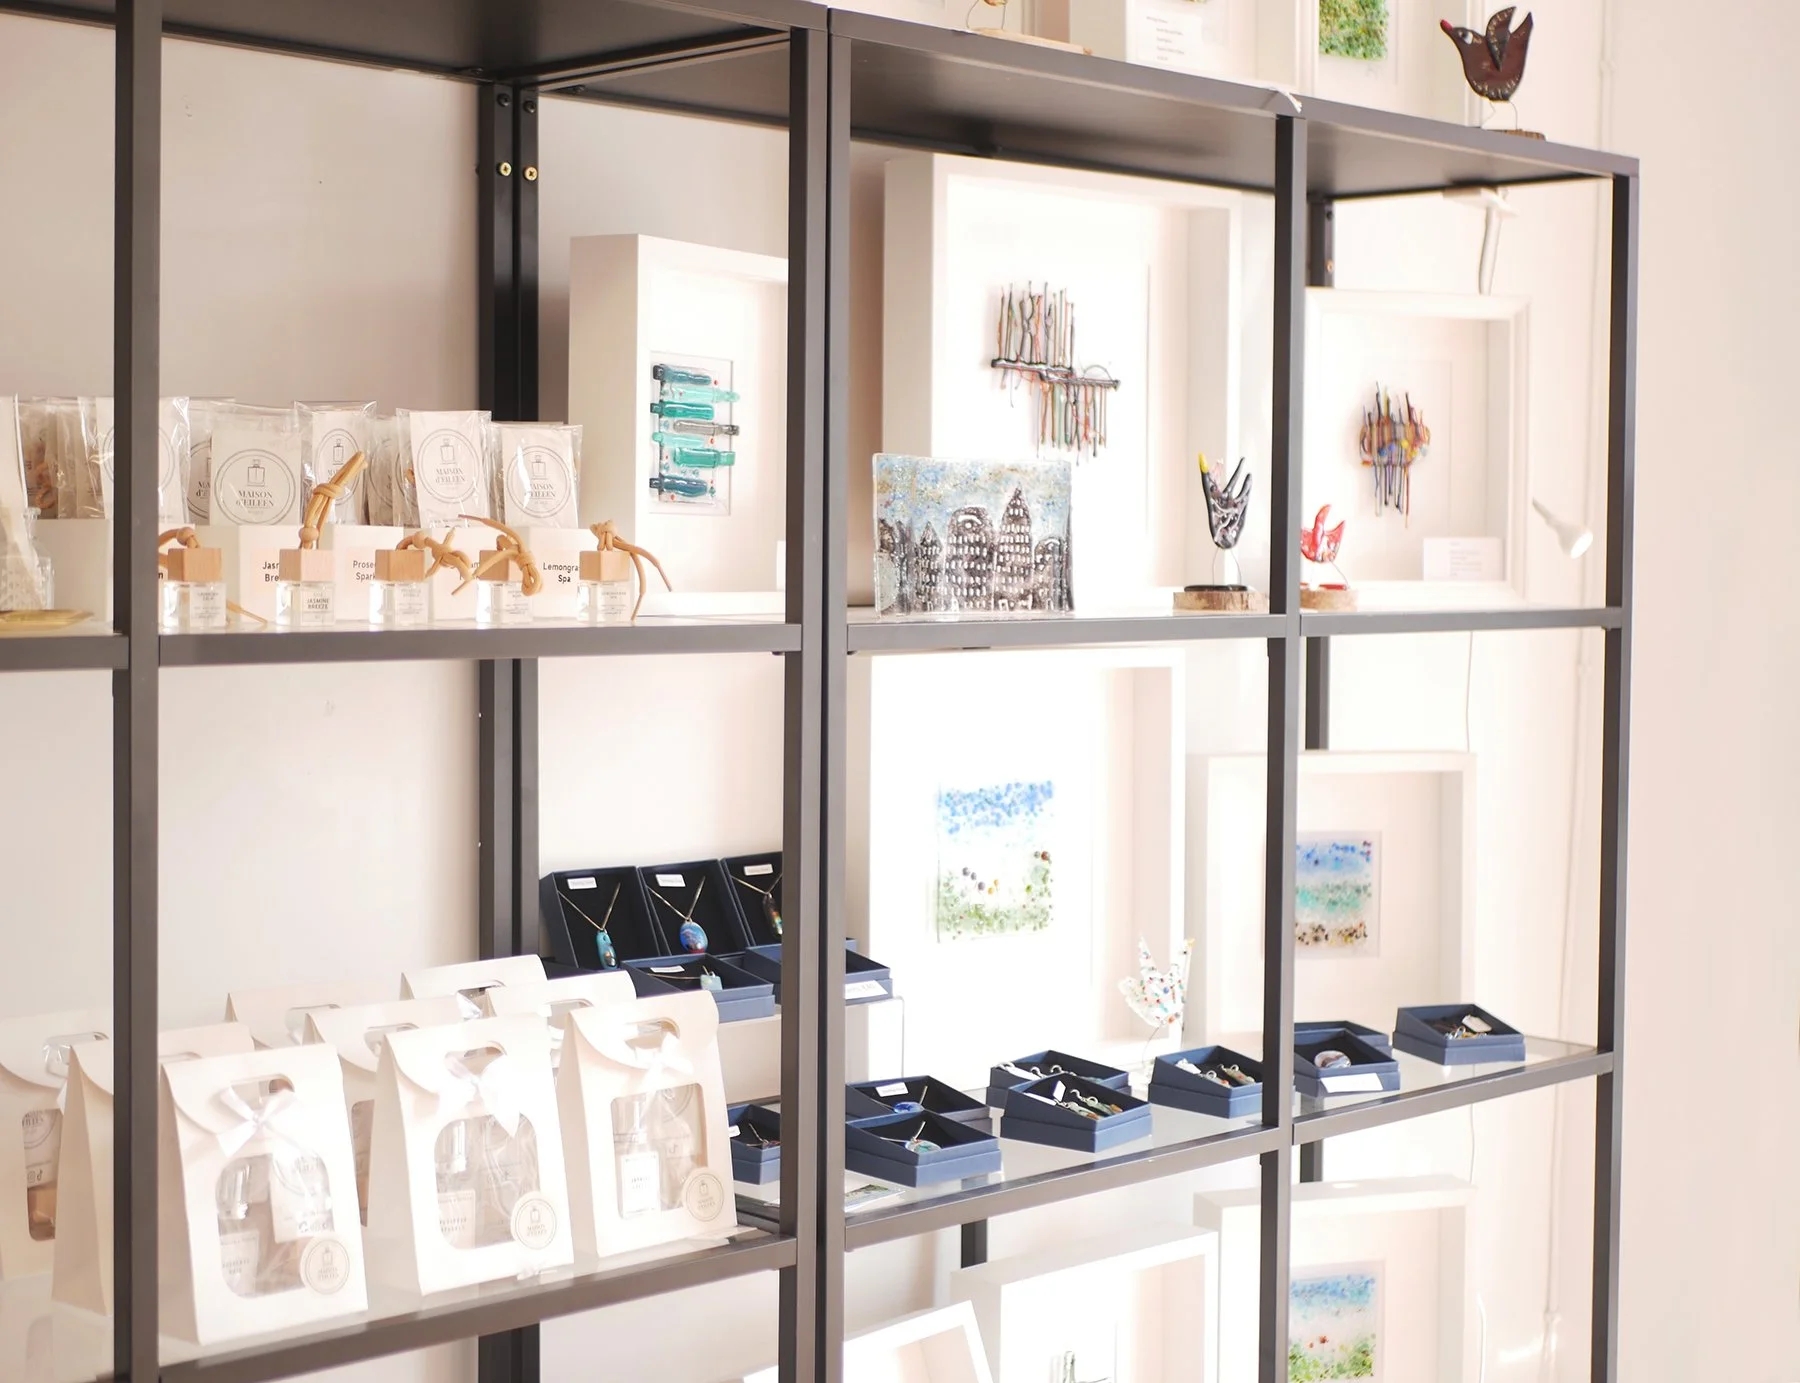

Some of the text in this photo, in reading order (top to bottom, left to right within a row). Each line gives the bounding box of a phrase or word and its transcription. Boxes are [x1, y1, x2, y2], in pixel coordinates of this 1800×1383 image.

[238, 490, 273, 499] MAISON
[352, 560, 376, 569] Prose
[542, 562, 579, 574] Lemongra
[265, 573, 279, 582] Bre
[557, 574, 571, 584] Spa
